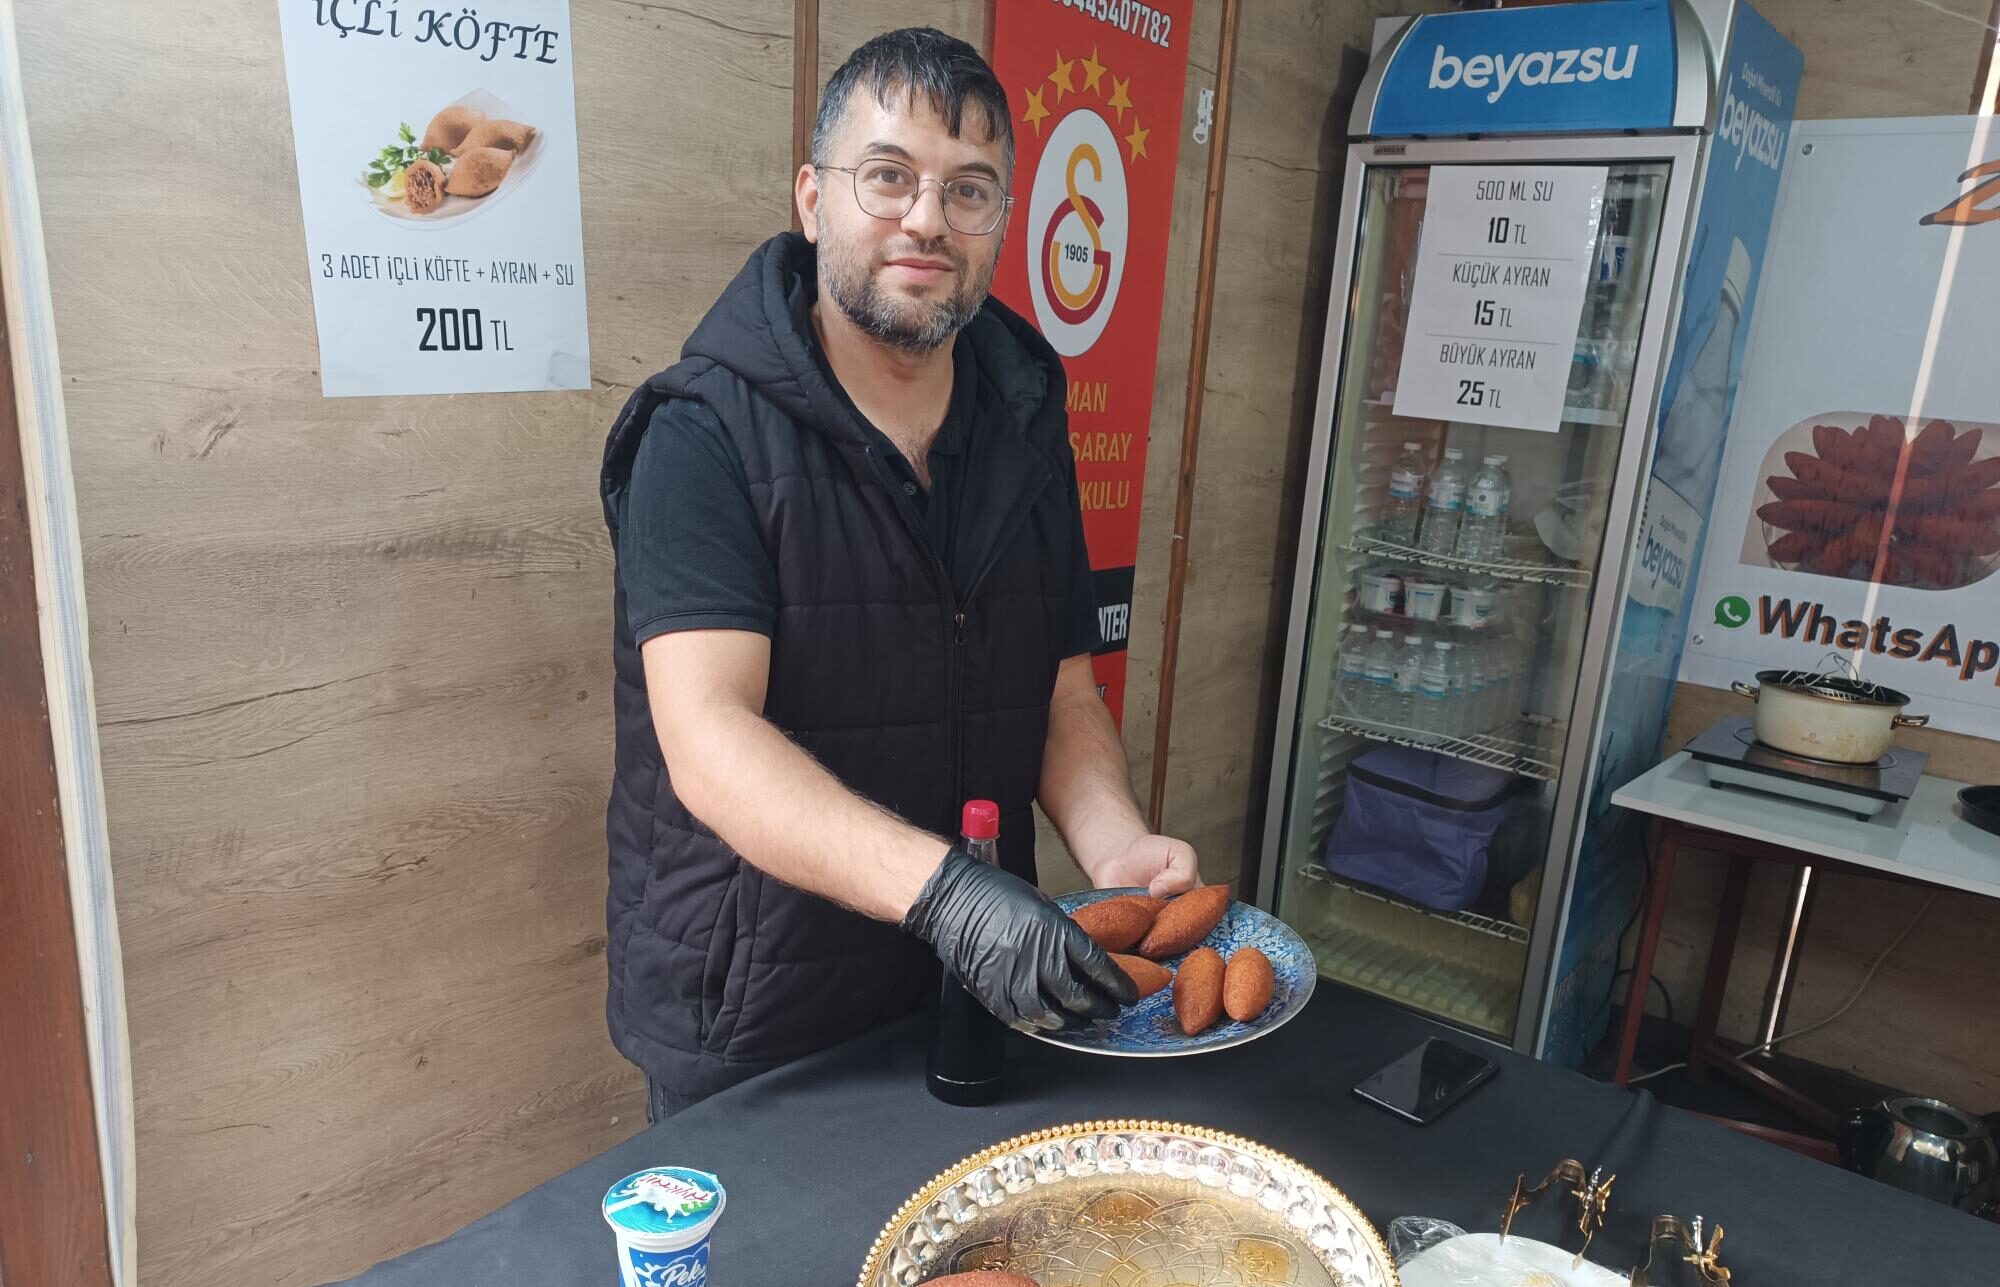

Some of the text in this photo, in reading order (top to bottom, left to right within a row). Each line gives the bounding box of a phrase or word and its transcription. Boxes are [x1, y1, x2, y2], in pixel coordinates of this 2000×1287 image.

[415, 8, 558, 64] KÖFTE
[1429, 45, 1638, 103] beyazsu
[1719, 72, 1784, 171] beyazsu
[1477, 180, 1554, 202] 500 ML SU
[1488, 217, 1527, 245] 10 TL
[1065, 243, 1088, 263] 1905
[322, 254, 334, 278] 3
[340, 255, 380, 279] ADET
[425, 256, 471, 283] KÖFTE
[491, 261, 538, 285] AYRAN
[556, 264, 574, 286] SU
[1453, 263, 1550, 289] KÜÇÜK AYRAN
[416, 308, 514, 351] 200 TL
[1473, 300, 1513, 328] 15 TL
[1439, 343, 1536, 370] BÜYÜK AYRAN
[1066, 381, 1107, 412] MAN
[1457, 380, 1502, 409] 25 TL
[1070, 431, 1132, 462] SARAY
[1080, 480, 1130, 511] KULU
[1641, 524, 1687, 590] beyazsu
[1098, 603, 1129, 642] NTER
[1758, 594, 2000, 687] WhatsAp
